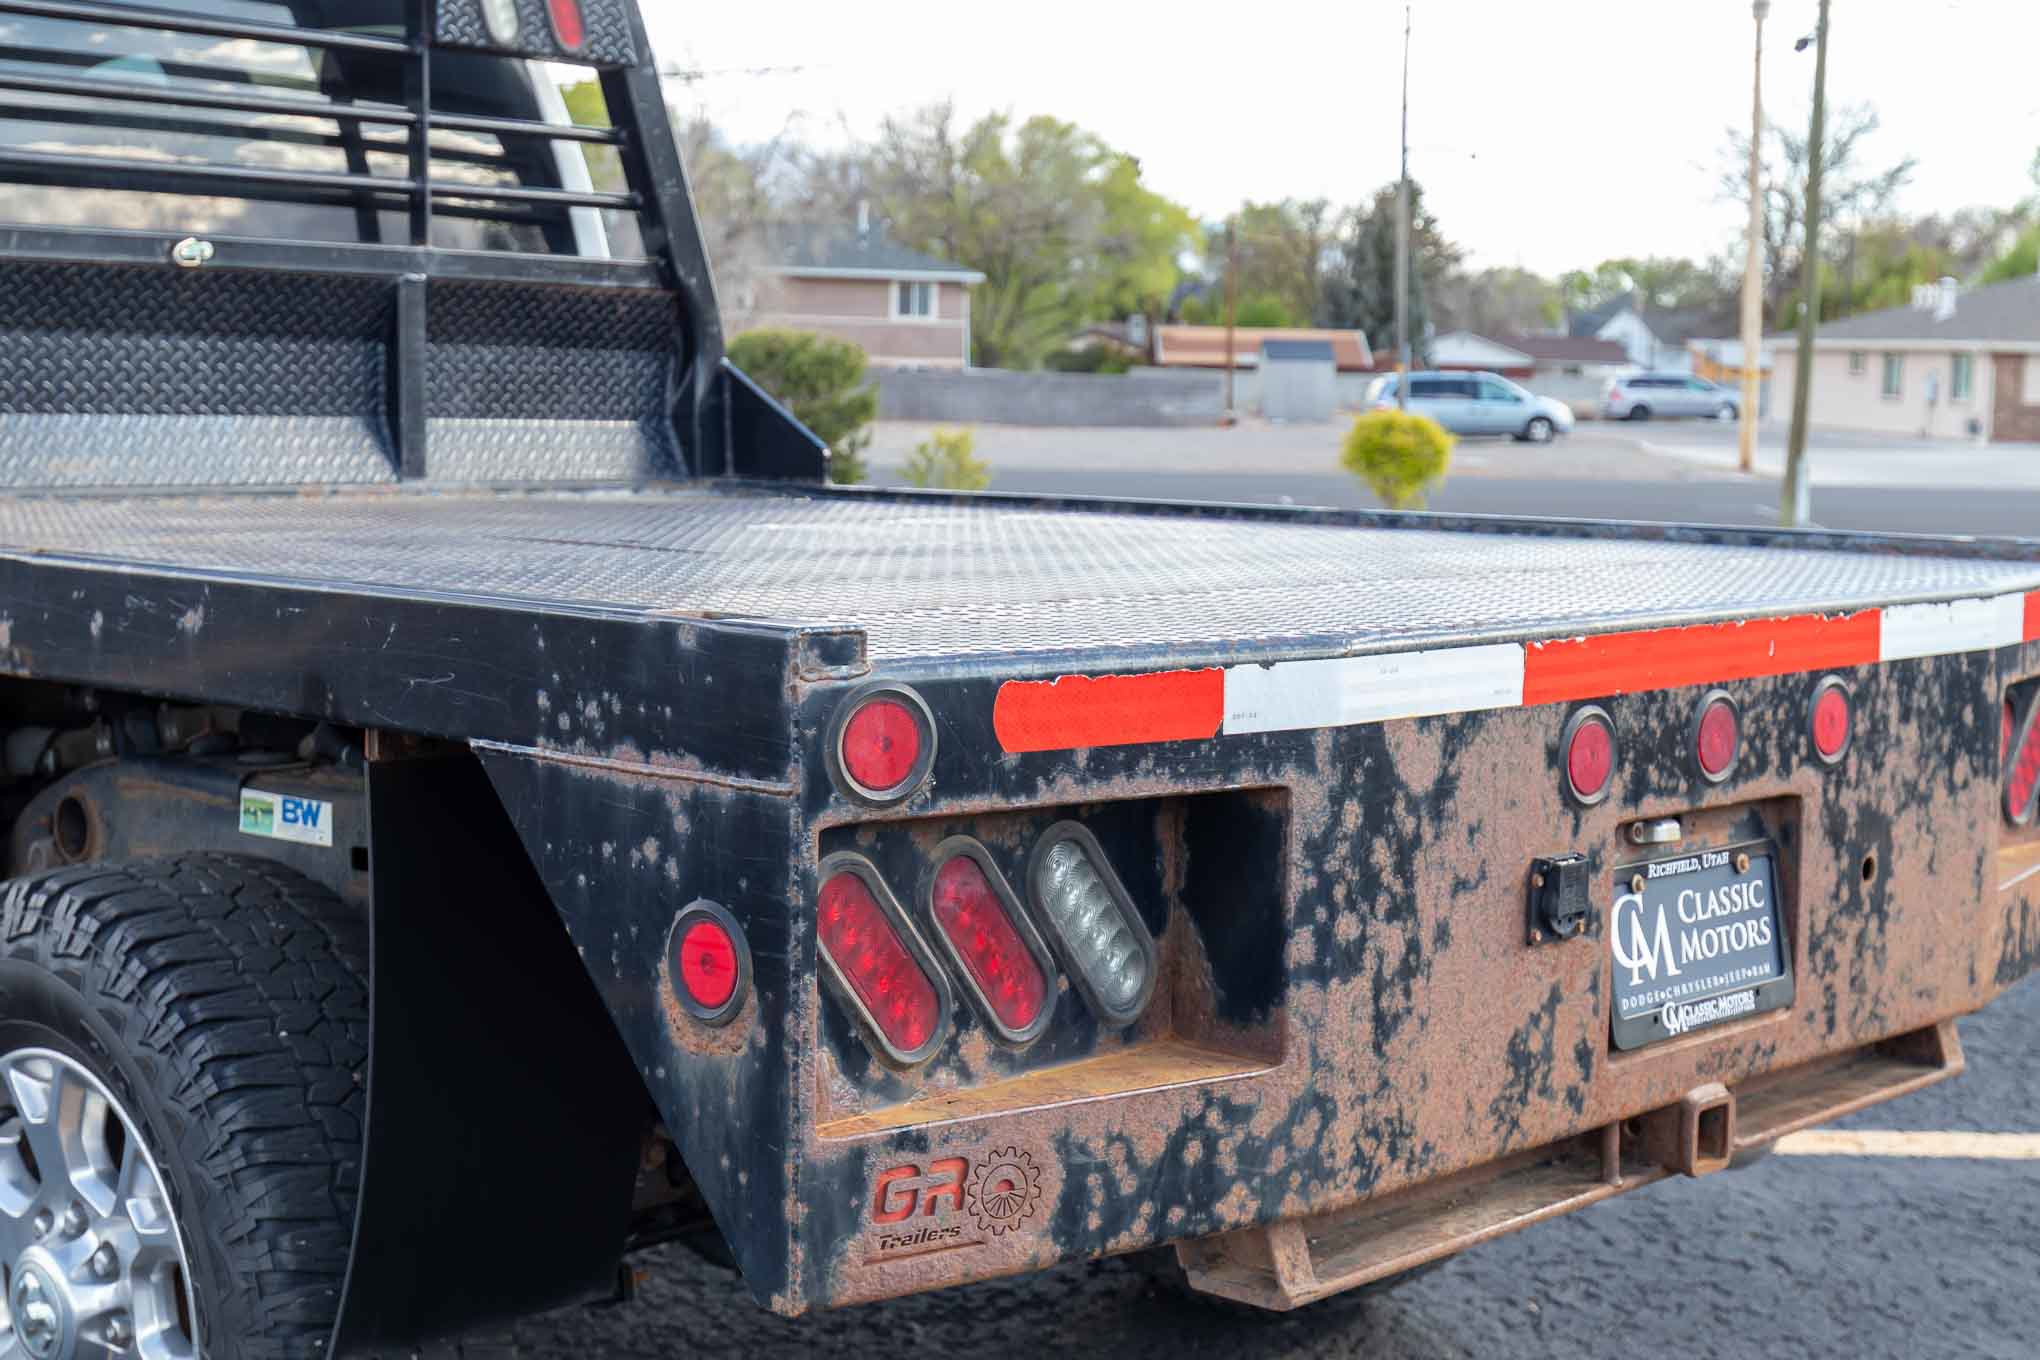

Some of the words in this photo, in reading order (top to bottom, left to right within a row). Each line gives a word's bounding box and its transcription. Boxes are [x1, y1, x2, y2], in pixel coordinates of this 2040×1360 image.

[1648, 858, 1702, 878] RICHFIELD,
[1702, 851, 1729, 868] UTAH
[1678, 879, 1765, 923] CLASSIC
[1680, 916, 1772, 964] MOTORS
[1717, 989, 1755, 1008] MOTORS
[880, 1224, 961, 1251] Trailers
